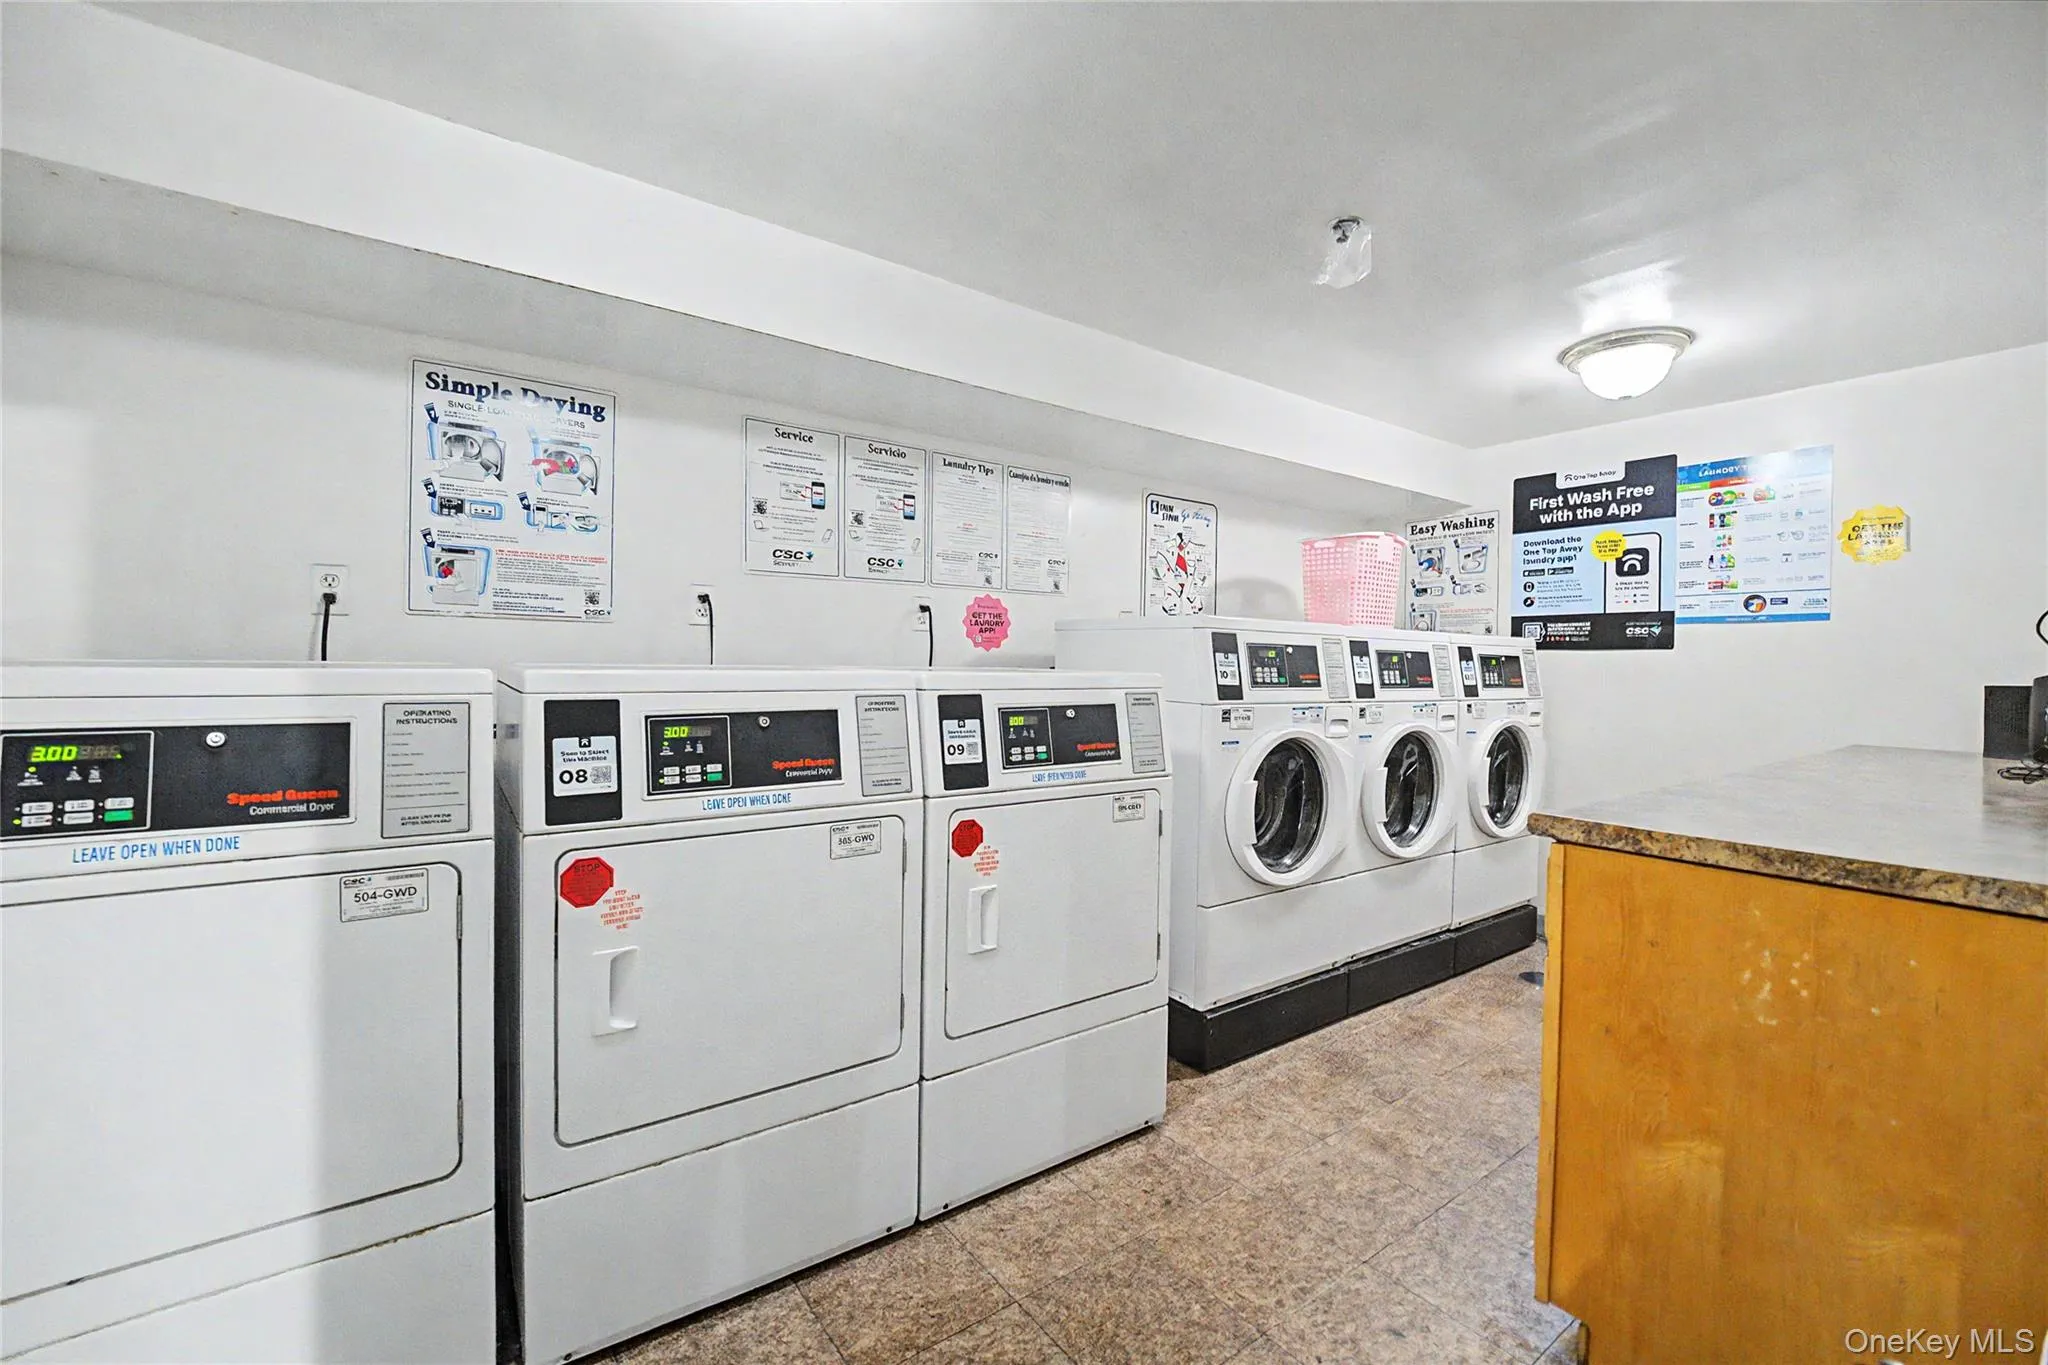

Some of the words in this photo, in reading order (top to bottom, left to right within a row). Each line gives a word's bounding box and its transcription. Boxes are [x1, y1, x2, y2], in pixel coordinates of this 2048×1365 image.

[425, 371, 514, 404] Simple
[521, 387, 606, 423] Drying
[775, 427, 814, 444] Service
[867, 442, 907, 460] Servicio
[943, 458, 977, 475] Laundry
[1529, 494, 1564, 511] First
[1567, 488, 1612, 506] Wash
[1616, 485, 1655, 500] Free
[1539, 508, 1573, 524] with
[1576, 506, 1604, 520] the
[1606, 502, 1643, 518] App
[1409, 524, 1438, 537] Easy
[1439, 516, 1496, 532] Washing
[1523, 537, 1566, 548] Download
[1566, 536, 1582, 544] the
[772, 548, 804, 561] CSC
[1523, 548, 1540, 557] One
[1542, 547, 1557, 556] Tap
[1559, 545, 1584, 554] Away
[867, 556, 895, 568] CSC
[1522, 557, 1555, 566] laundry
[972, 612, 987, 620] GET
[988, 612, 1003, 621] THE
[1625, 626, 1649, 635] CSC
[947, 743, 965, 756] 09
[772, 759, 804, 771] Speed
[559, 768, 588, 784] 08
[227, 790, 283, 804] Speed
[284, 788, 339, 800] Queen
[249, 803, 307, 816] Commercial
[309, 802, 336, 814] Dryer
[72, 842, 118, 864] LEAVE
[119, 840, 159, 860] OPEN
[162, 838, 202, 857] WHEN
[205, 835, 240, 853] DONE
[574, 863, 601, 873] STOP
[354, 886, 418, 903] 504-GWD
